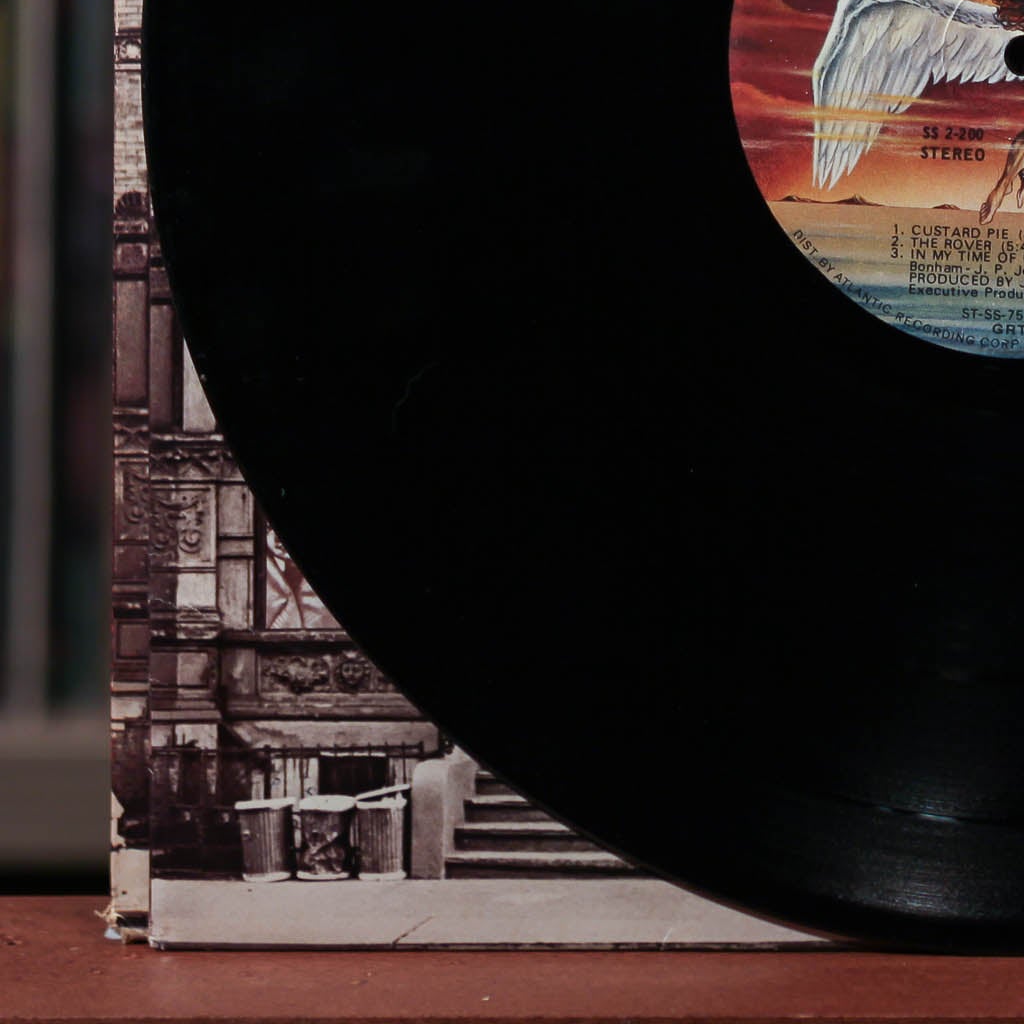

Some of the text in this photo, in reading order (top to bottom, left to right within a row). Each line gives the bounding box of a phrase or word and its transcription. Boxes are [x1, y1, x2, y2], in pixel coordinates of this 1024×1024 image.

[922, 126, 985, 141] SS 2-200
[920, 146, 985, 161] STEREO
[893, 223, 904, 235] 1.
[911, 224, 981, 239] CUSTARD
[987, 228, 1009, 240] PIE
[890, 236, 904, 247] 2.
[910, 237, 938, 249] THE
[944, 238, 992, 251] ROVER
[890, 247, 903, 259] 3.
[911, 249, 926, 260] IN
[932, 250, 952, 261] MY
[958, 251, 991, 262] TIME
[997, 252, 1017, 264] OF
[909, 272, 990, 286] PRODUCED
[996, 277, 1013, 288] BY
[908, 284, 978, 297] Executive
[818, 257, 836, 273] BY
[833, 272, 892, 314] ATLANTIC
[895, 311, 976, 346] RECORDING
